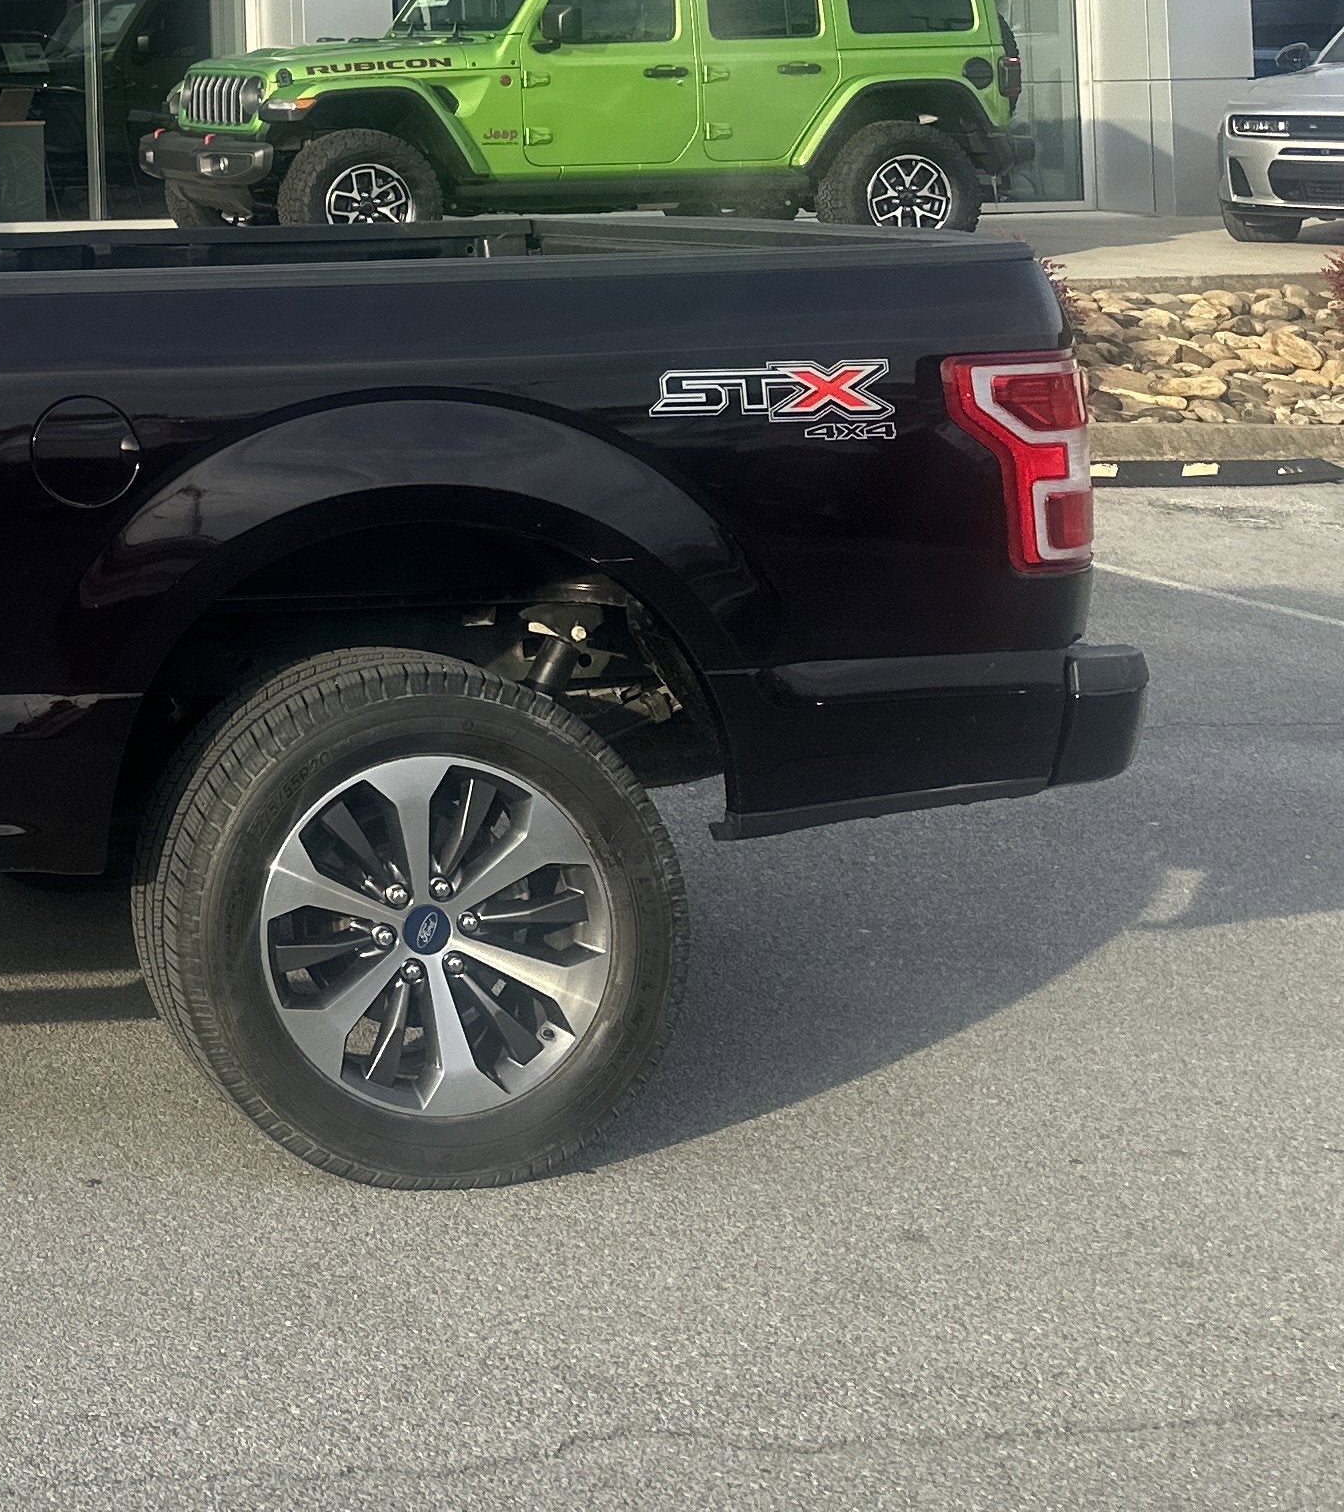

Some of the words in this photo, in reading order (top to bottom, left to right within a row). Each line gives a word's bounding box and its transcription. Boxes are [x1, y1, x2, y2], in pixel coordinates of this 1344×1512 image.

[305, 57, 453, 76] RUBICON
[483, 127, 519, 141] Jeep
[648, 358, 896, 423] STX
